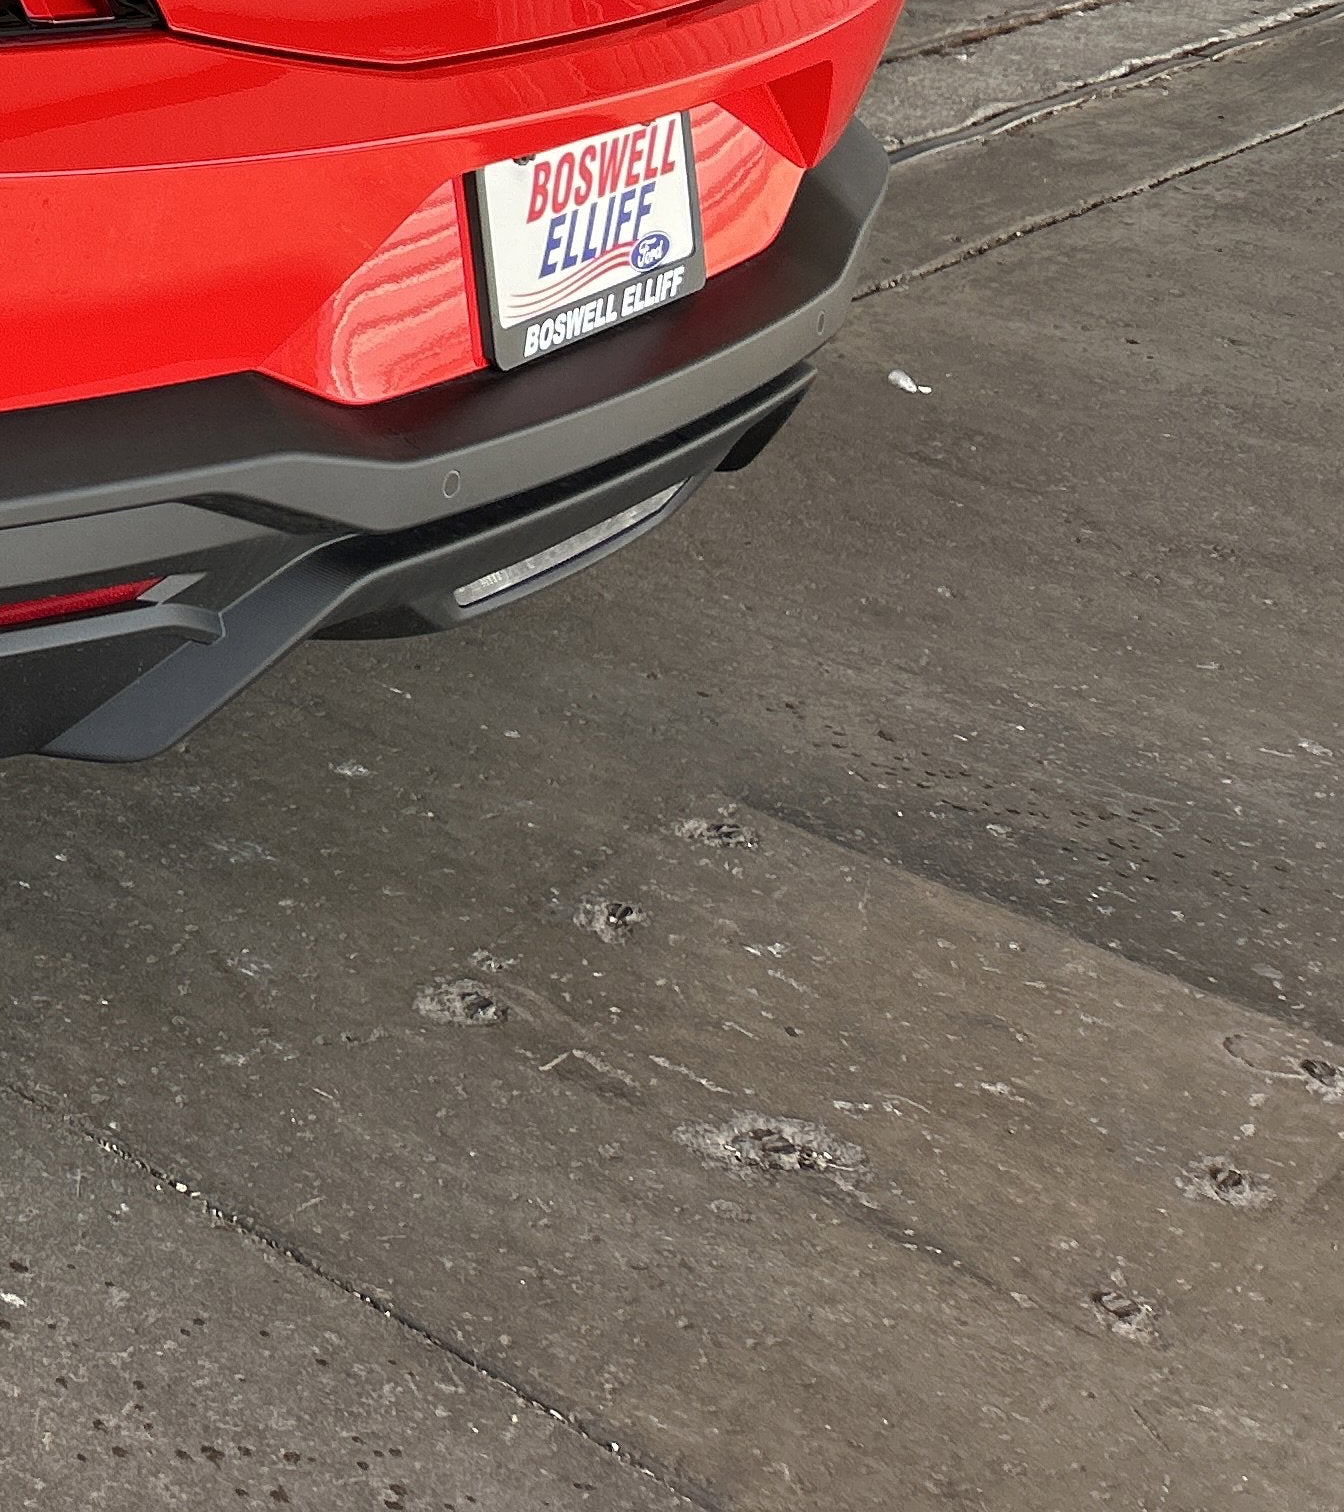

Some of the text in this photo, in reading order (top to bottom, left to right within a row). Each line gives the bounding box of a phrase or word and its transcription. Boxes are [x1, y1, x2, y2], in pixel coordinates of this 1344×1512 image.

[527, 119, 676, 224] BOSWELL
[538, 181, 656, 279] ELLIFF
[635, 236, 666, 269] Ford
[523, 267, 686, 358] BOSWELL ELLIFF
